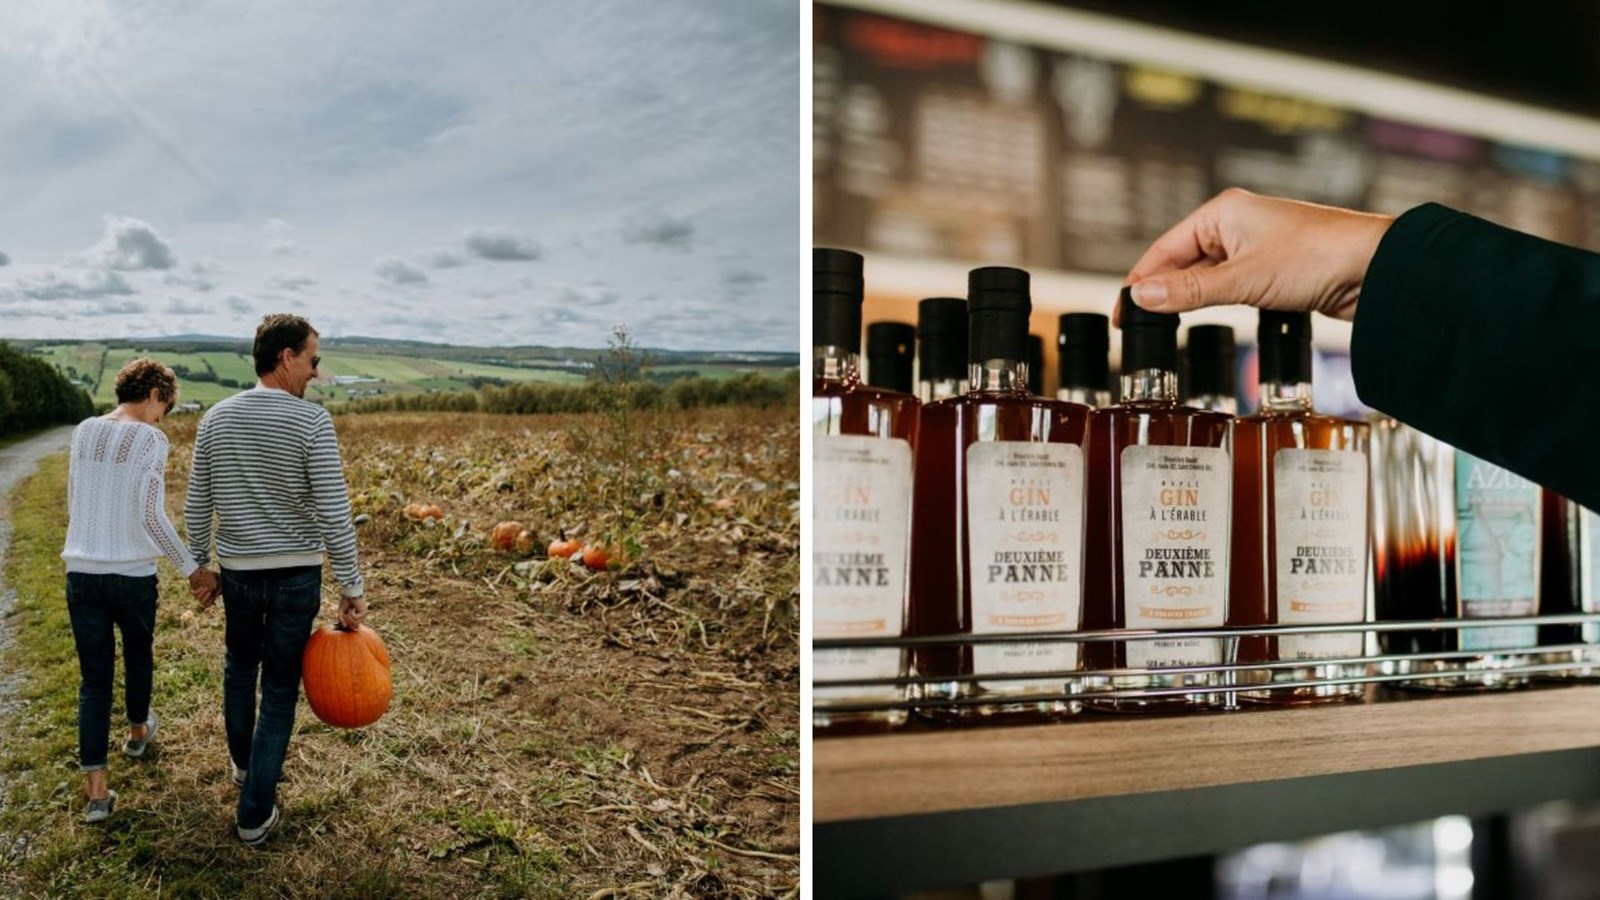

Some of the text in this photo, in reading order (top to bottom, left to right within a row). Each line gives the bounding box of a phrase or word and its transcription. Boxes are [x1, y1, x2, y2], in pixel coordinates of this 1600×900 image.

[1009, 487, 1050, 506] GIN
[1160, 489, 1199, 506] GIN
[999, 507, 1060, 522] À L'ÉRABLE
[1149, 506, 1207, 522] À L'ÉRABLE
[994, 548, 1065, 564] DEUXIÈME
[1145, 546, 1211, 560] DEUXIÈME
[988, 564, 1068, 583] PANNE
[1139, 561, 1215, 578] PANNE
[1291, 558, 1356, 574] PANNE
